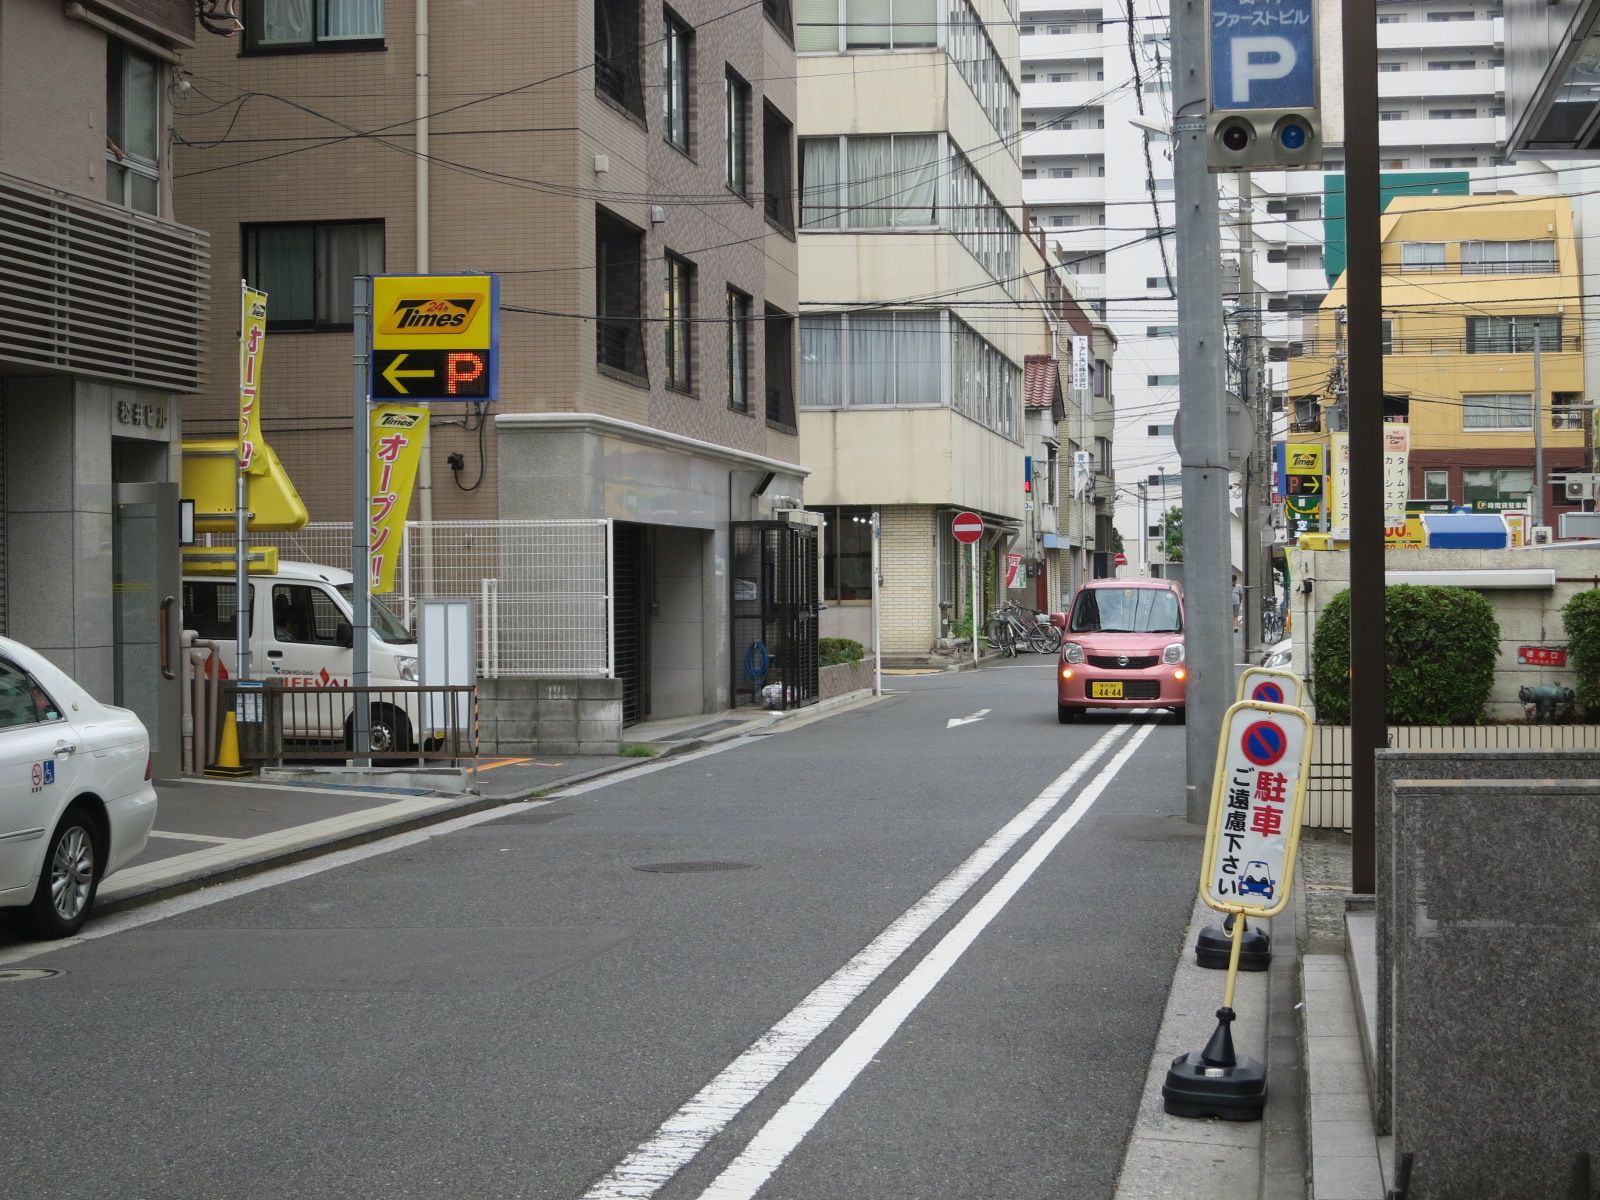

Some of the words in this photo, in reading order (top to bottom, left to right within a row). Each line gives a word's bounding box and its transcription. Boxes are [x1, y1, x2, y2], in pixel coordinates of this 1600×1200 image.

[1213, 9, 1310, 28] ファーストビル
[1231, 36, 1297, 102] P
[397, 308, 465, 328] Times
[448, 353, 483, 394] P
[382, 416, 414, 427] Times
[1294, 456, 1316, 466] Times
[1385, 456, 1393, 510] カーシェア
[1396, 457, 1406, 510] タイムズで
[1340, 467, 1349, 520] カーシェア
[1251, 771, 1288, 838] 駐車
[1218, 768, 1254, 895] ご遠慮下さい
